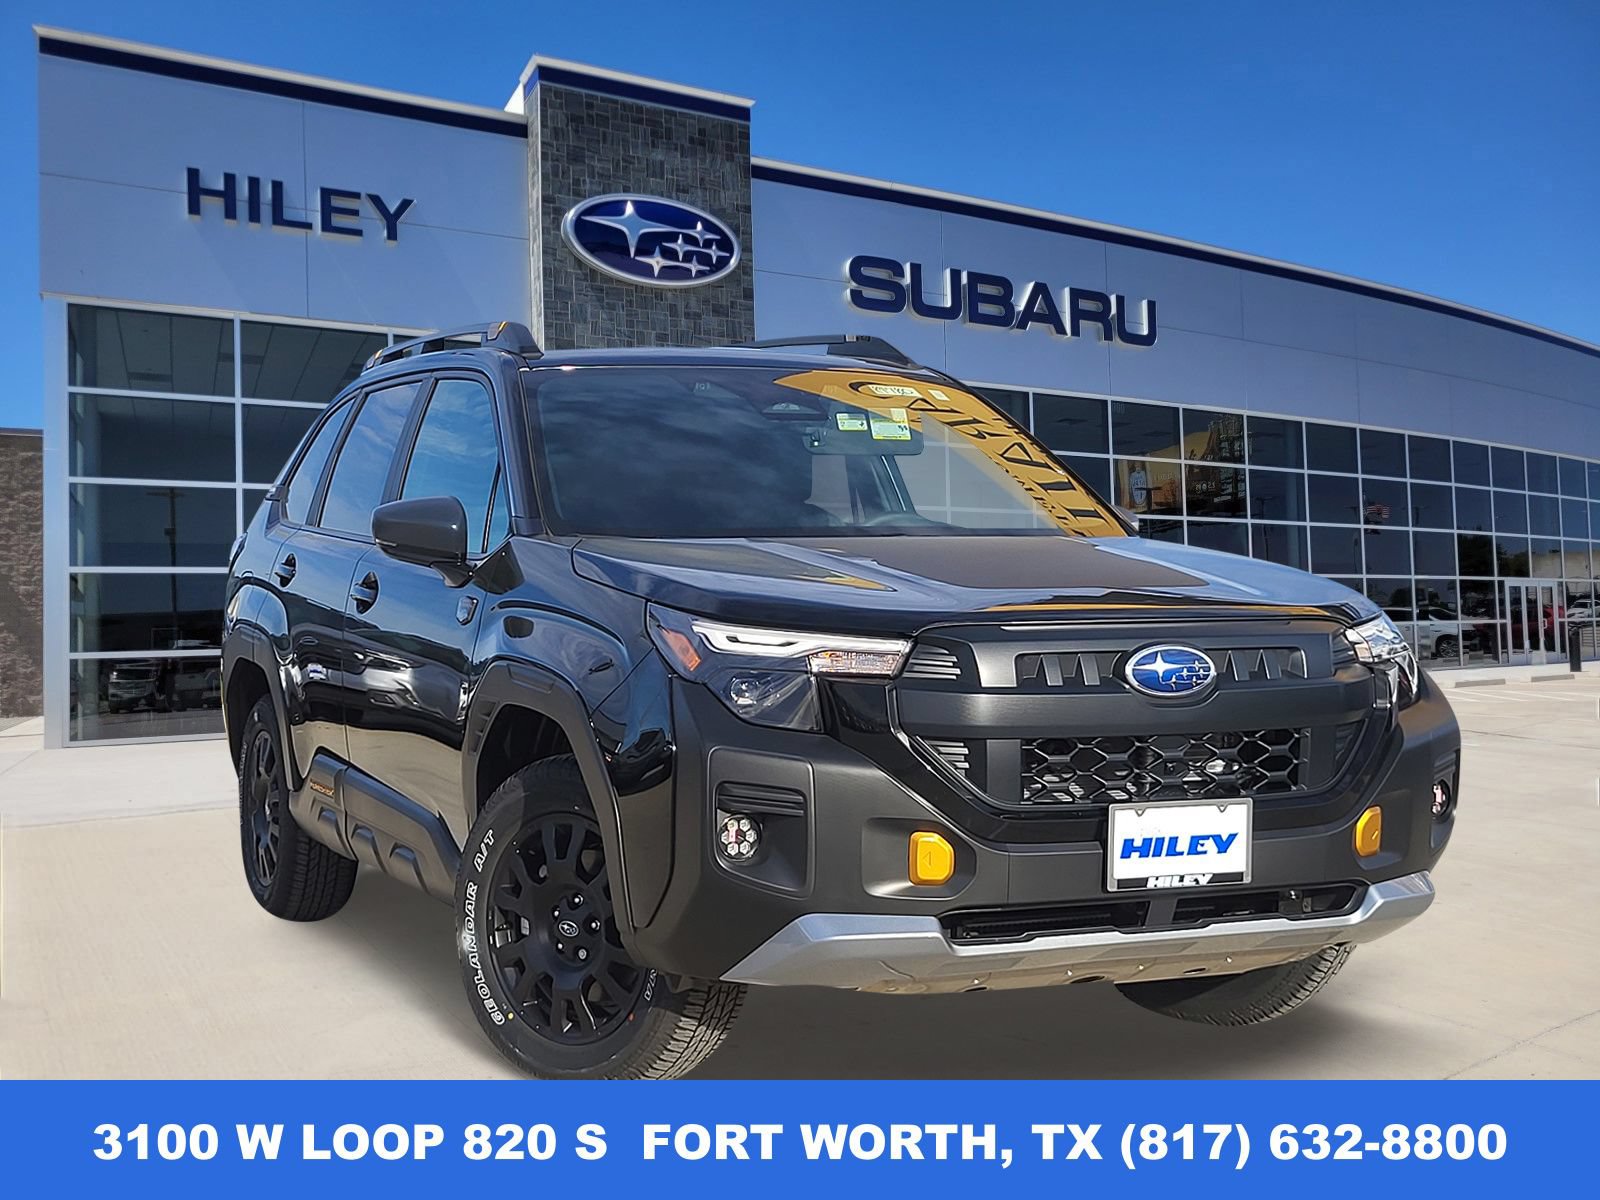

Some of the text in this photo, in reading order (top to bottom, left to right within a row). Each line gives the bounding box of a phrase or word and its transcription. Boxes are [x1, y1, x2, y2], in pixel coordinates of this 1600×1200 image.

[186, 167, 416, 242] HILEY
[847, 255, 1158, 347] SUBARU
[1120, 832, 1239, 859] HILEY
[1146, 873, 1214, 889] HILEY
[464, 828, 506, 1026] GEOLANDAR A/T
